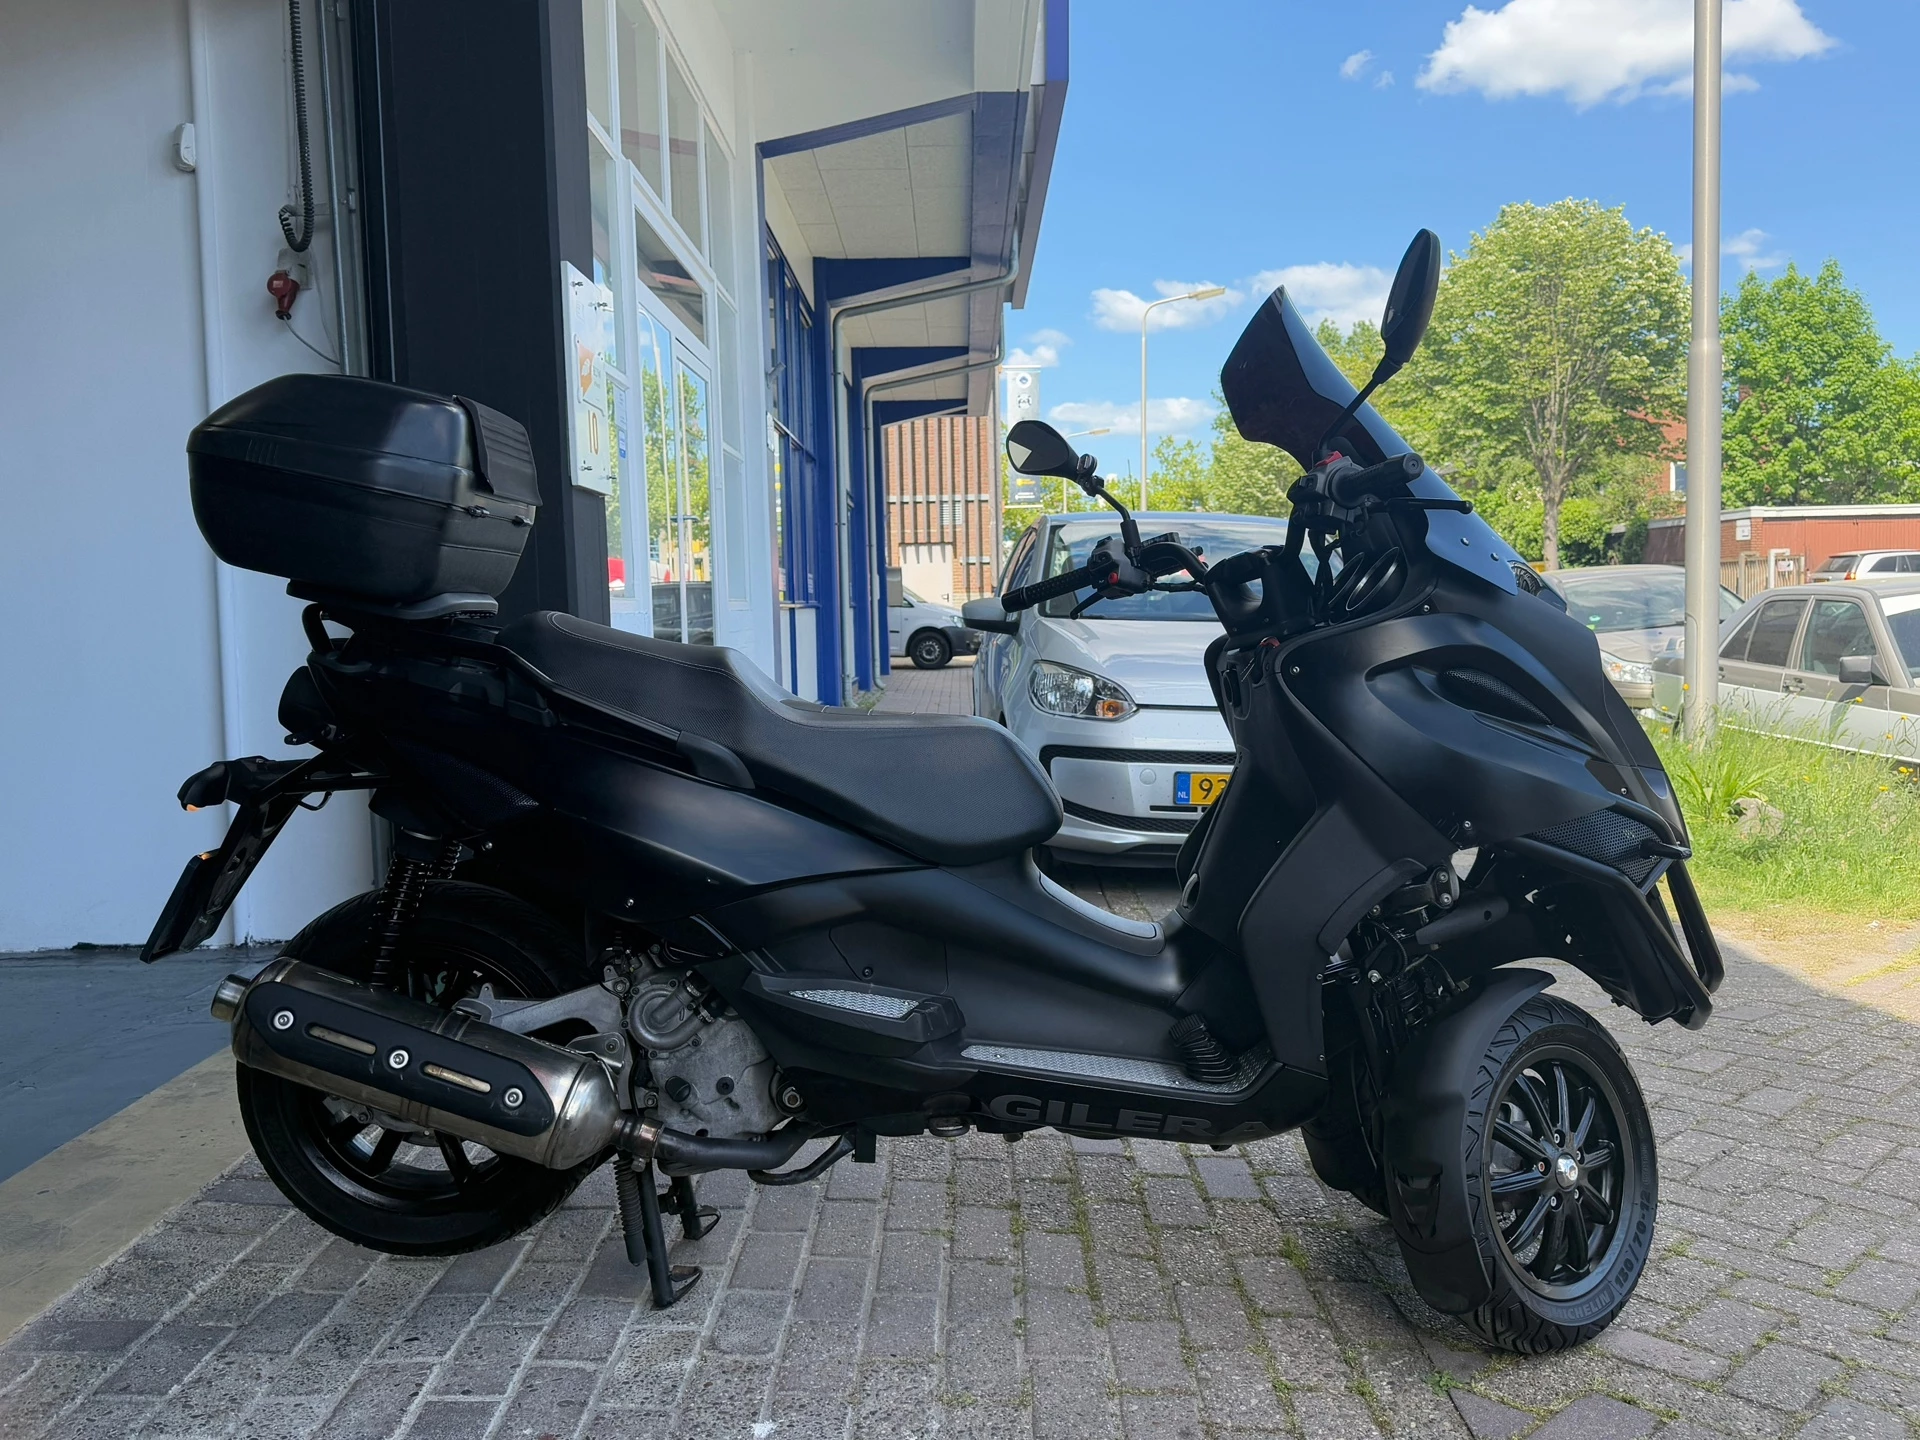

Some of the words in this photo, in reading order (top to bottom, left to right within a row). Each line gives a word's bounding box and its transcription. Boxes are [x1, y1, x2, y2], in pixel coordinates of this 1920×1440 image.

[1177, 791, 1188, 799] NL
[989, 1094, 1276, 1137] GILERA
[1548, 1290, 1611, 1320] MICHELIN
